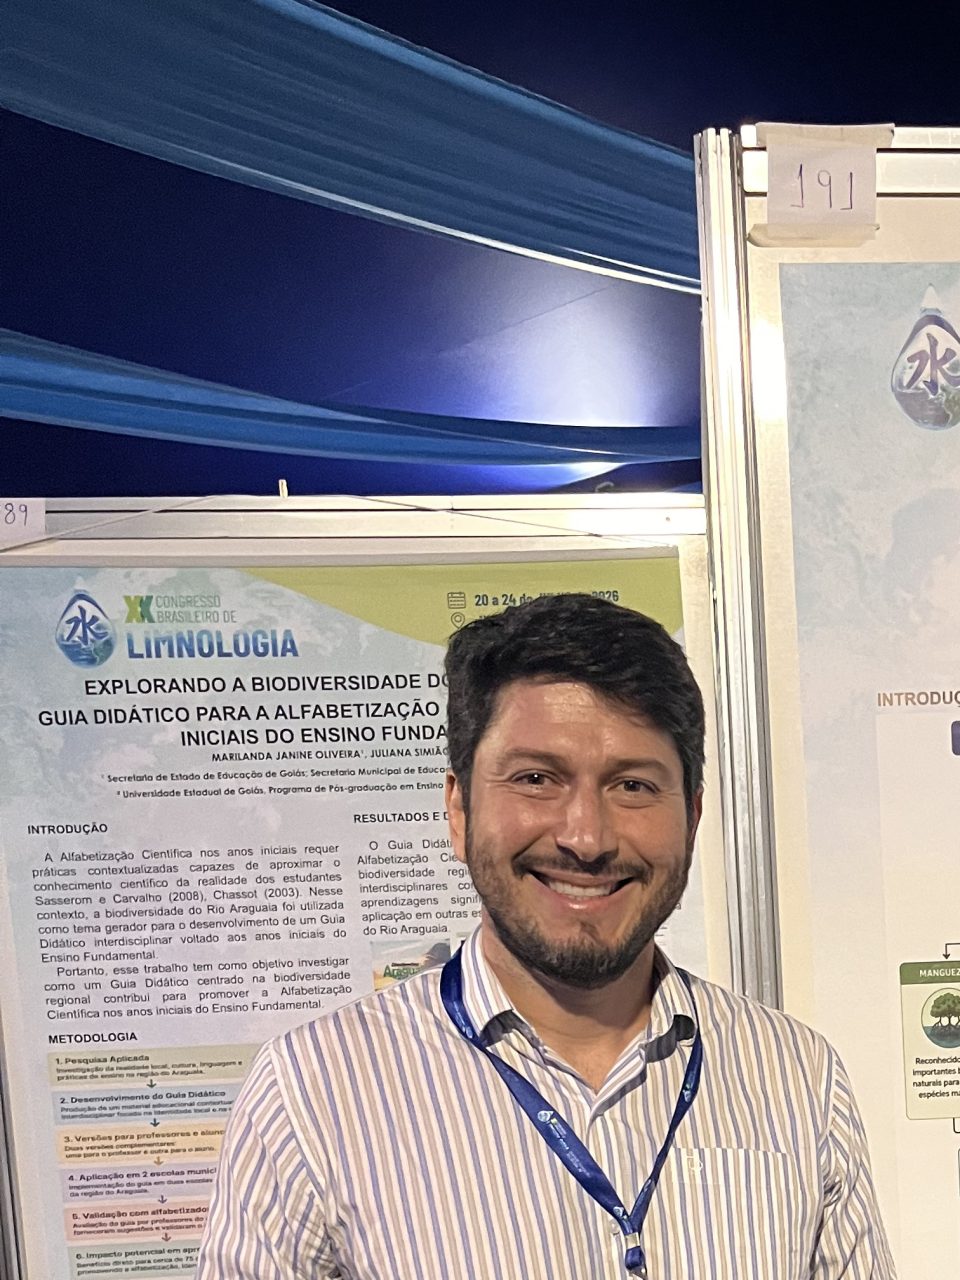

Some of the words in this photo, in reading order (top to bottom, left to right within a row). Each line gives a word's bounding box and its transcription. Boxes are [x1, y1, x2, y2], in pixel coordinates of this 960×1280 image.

[156, 595, 221, 608] CONGRESSO
[157, 610, 219, 623] BRASILEIRO
[223, 610, 237, 623] DE
[126, 629, 299, 659] LIMNOLOGIA
[84, 677, 226, 695] EXPLORANDO
[232, 676, 246, 691] A
[251, 673, 421, 691] BIODIVERSIDADE
[38, 709, 88, 726] GUIA
[93, 704, 189, 724] DIDÁTICO
[196, 705, 251, 721] PARA
[255, 705, 269, 720] A
[274, 698, 439, 721] ALFABETIZAÇÃO
[180, 728, 258, 746] INICIAIS
[265, 728, 294, 743] DO
[300, 726, 375, 743] ENSINO
[212, 751, 272, 761] MARILANDA
[276, 750, 312, 760] JANINE
[370, 748, 411, 757] JULIANA
[353, 812, 429, 823] RESULTADOS
[432, 811, 439, 820] E
[27, 821, 107, 835] INTRODUÇÃO
[44, 852, 53, 862] A
[60, 850, 134, 862] Alfabetização
[141, 848, 192, 859] Científica
[200, 849, 219, 857] nos
[227, 848, 253, 856] anos
[261, 845, 296, 855] iniciais
[304, 845, 339, 855] requer
[48, 1032, 137, 1043] METODOLOGIA
